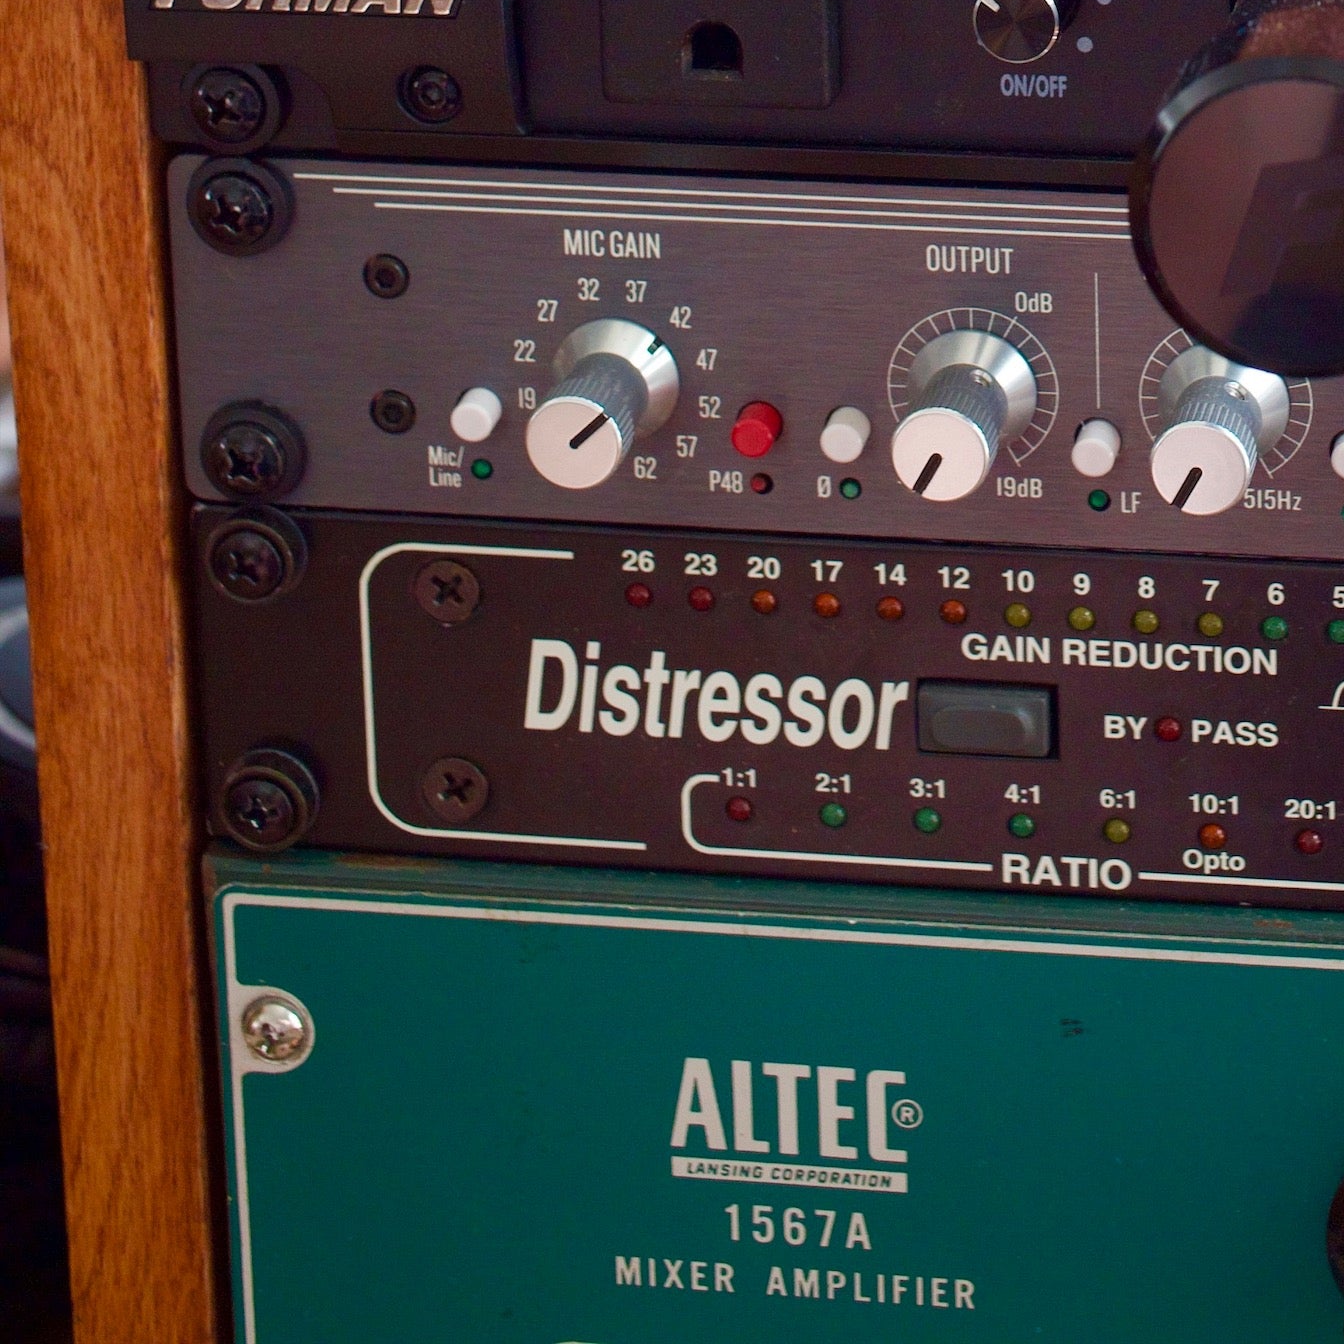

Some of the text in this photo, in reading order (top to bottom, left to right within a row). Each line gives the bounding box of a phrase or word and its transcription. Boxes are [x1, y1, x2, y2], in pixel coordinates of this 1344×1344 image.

[1000, 74, 1068, 100] ON/OFF
[563, 229, 661, 259] MIC GAIN
[926, 244, 1014, 274] OUTPUT
[577, 278, 647, 303] 32 37
[1015, 291, 1053, 313] 0dB
[537, 299, 559, 322] 27
[669, 307, 692, 329] 42
[513, 340, 536, 363] 22
[696, 349, 718, 372] 47
[518, 388, 536, 410] 19
[698, 396, 721, 419] 52
[428, 445, 465, 468] Mic/
[676, 436, 698, 458] 57
[429, 465, 462, 488] Line
[634, 457, 657, 479] 62
[709, 470, 744, 494] P48
[997, 476, 1043, 499] 19dB
[1121, 491, 1141, 513] LF
[1243, 487, 1302, 511] 515Hz
[621, 549, 655, 573] 26
[683, 553, 718, 576] 23
[747, 556, 781, 580] 20
[810, 559, 843, 582] 17
[873, 563, 906, 586] 14
[937, 566, 970, 589] 12
[1001, 569, 1035, 593] 10
[1073, 573, 1091, 596] 9
[1137, 576, 1156, 599] 8
[1202, 579, 1220, 602] 7
[1266, 582, 1285, 606] 6
[960, 633, 1279, 676] GAIN REDUCTION
[523, 637, 909, 751] Distressor
[1103, 714, 1279, 748] BY PASS
[720, 767, 758, 789] 1:1
[814, 772, 852, 795] 2:1
[908, 777, 946, 800] 3:1
[1003, 782, 1042, 806] 4:1
[1099, 788, 1138, 811] 6:1
[1188, 792, 1241, 816] 10:1
[1284, 798, 1338, 822] 20:1
[1001, 853, 1133, 891] RATIO
[1182, 847, 1246, 875] Opto
[686, 1162, 892, 1188] LANSING CORPORATION
[724, 1203, 872, 1250] 1567A
[615, 1254, 975, 1310] MIXER AMPLIFIER
